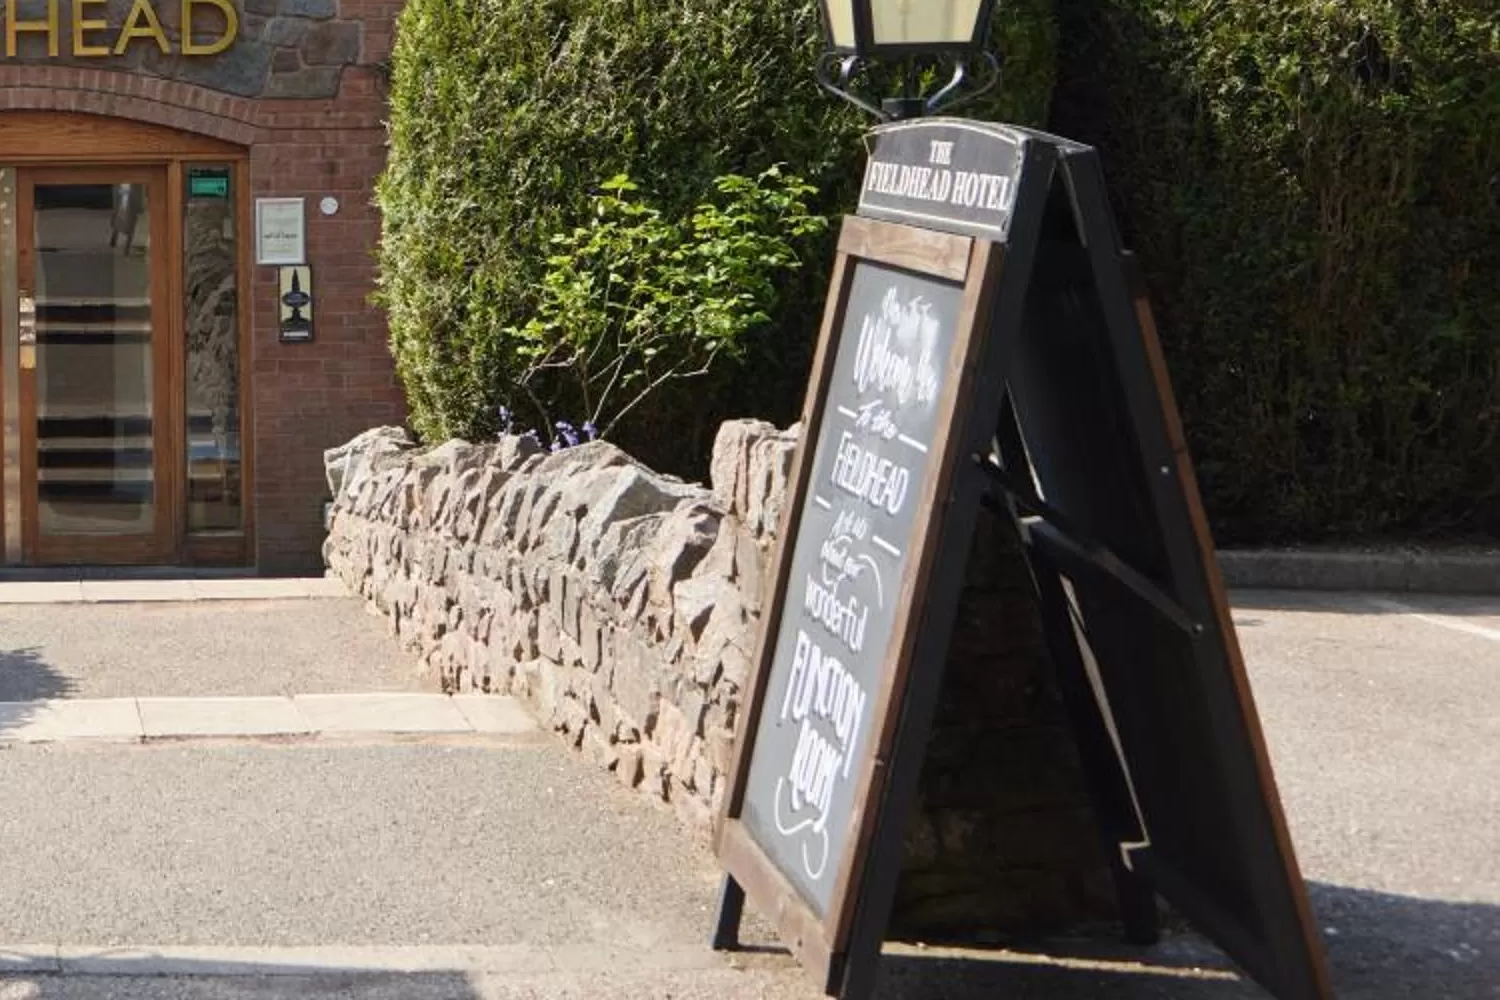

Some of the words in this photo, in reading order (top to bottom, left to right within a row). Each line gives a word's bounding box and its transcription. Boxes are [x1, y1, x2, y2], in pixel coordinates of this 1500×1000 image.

[929, 140, 954, 165] THE
[867, 160, 953, 202] FIELDHEAD
[951, 171, 1013, 211] HOTEL
